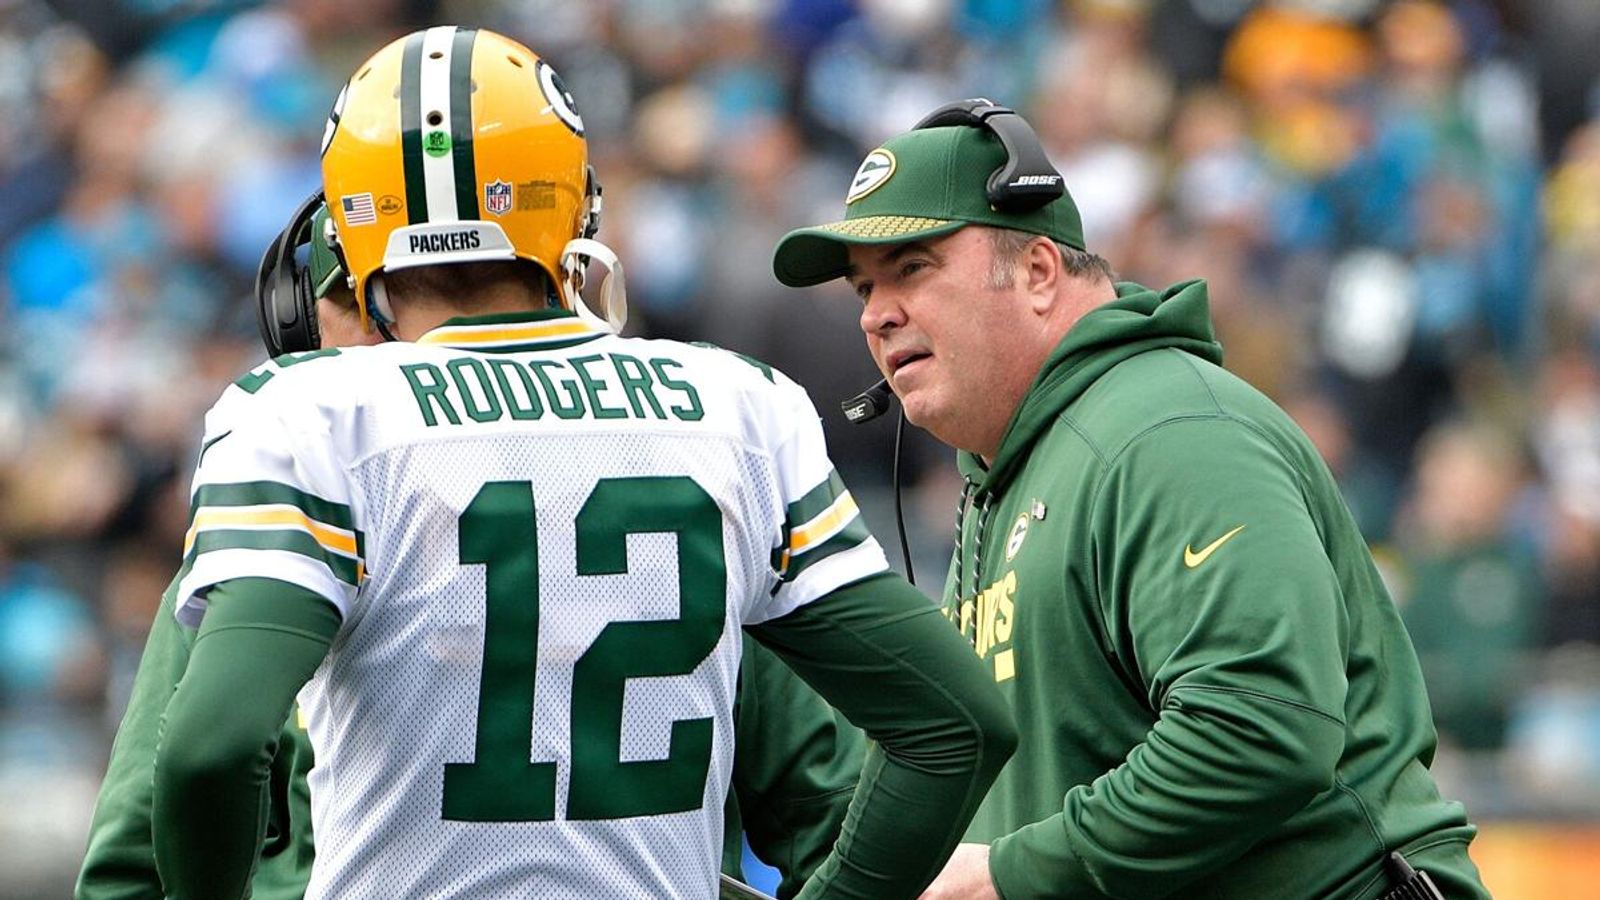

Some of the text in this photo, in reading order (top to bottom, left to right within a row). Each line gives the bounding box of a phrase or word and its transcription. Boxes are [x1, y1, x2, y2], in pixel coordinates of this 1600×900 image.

[1009, 175, 1061, 187] BOSE
[489, 195, 511, 210] NFL
[409, 229, 481, 253] PACKERS
[399, 352, 705, 427] RODGERS
[441, 475, 727, 822] 12
